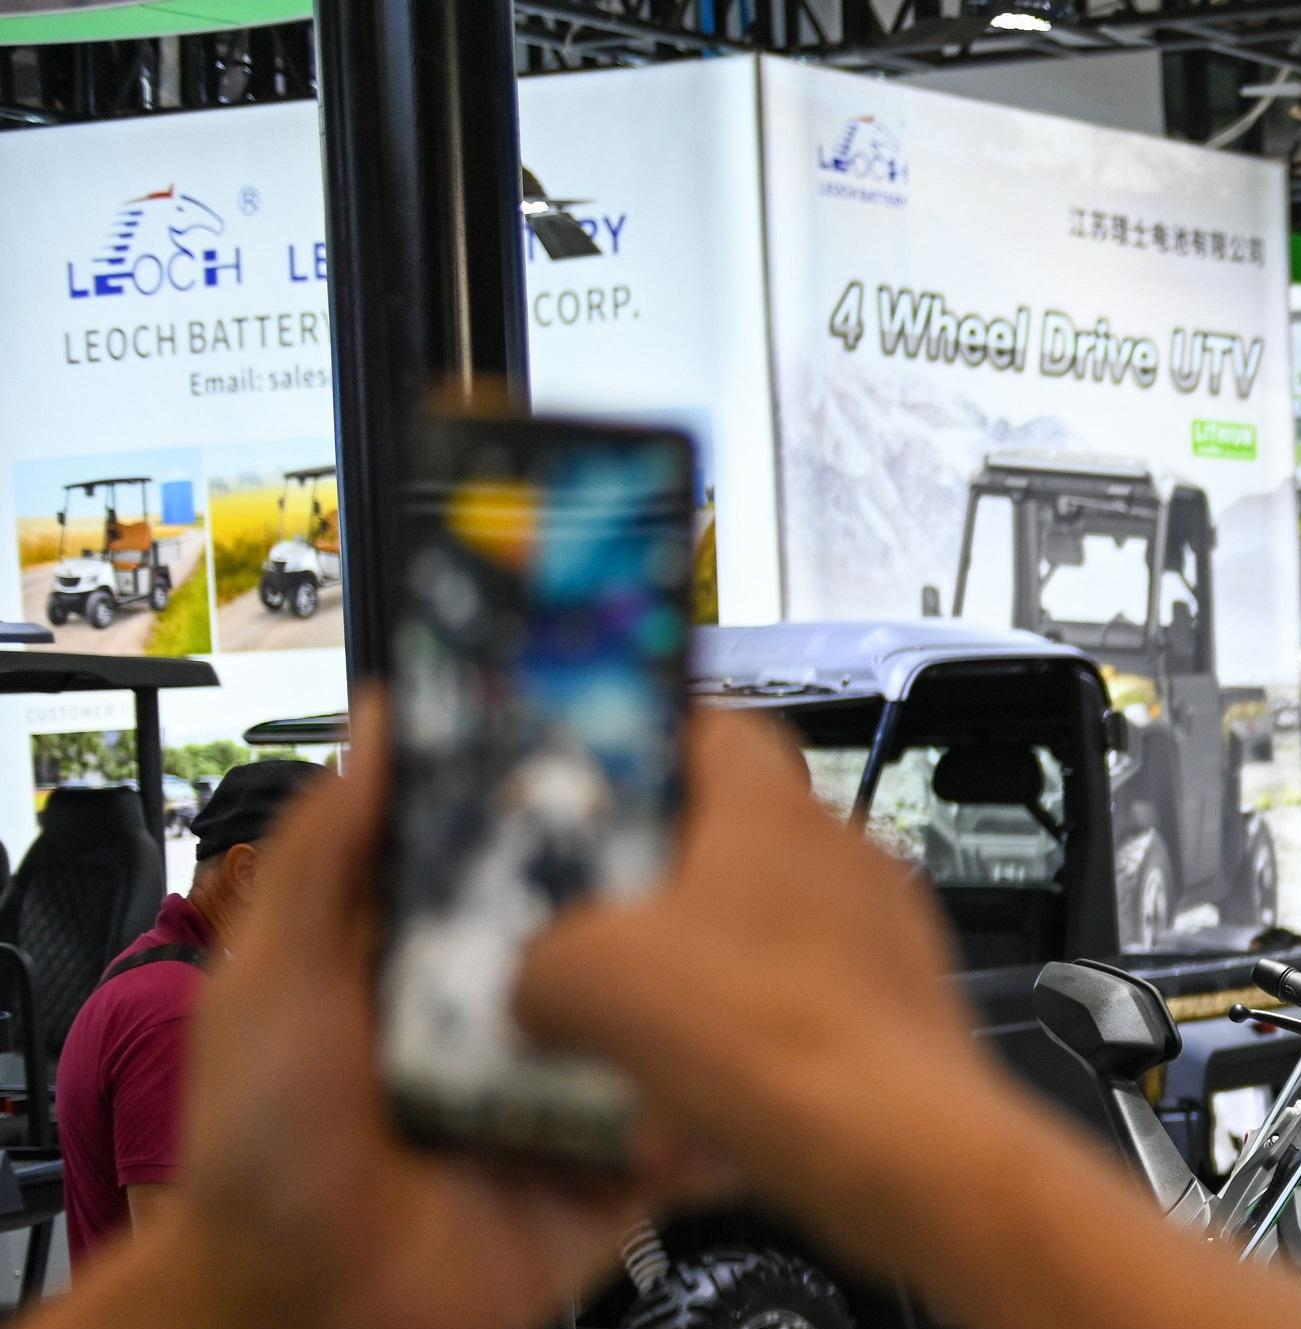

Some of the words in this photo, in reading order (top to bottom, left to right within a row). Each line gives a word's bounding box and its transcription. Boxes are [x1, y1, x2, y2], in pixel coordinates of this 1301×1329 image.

[64, 323, 178, 365] LEOCH
[532, 283, 641, 329] CORP.
[829, 280, 865, 352] 4
[876, 285, 1030, 373] Wheel
[1039, 310, 1159, 389] Drive
[1170, 327, 1265, 400] UTV
[189, 366, 263, 398] Email:
[268, 364, 331, 393] sales
